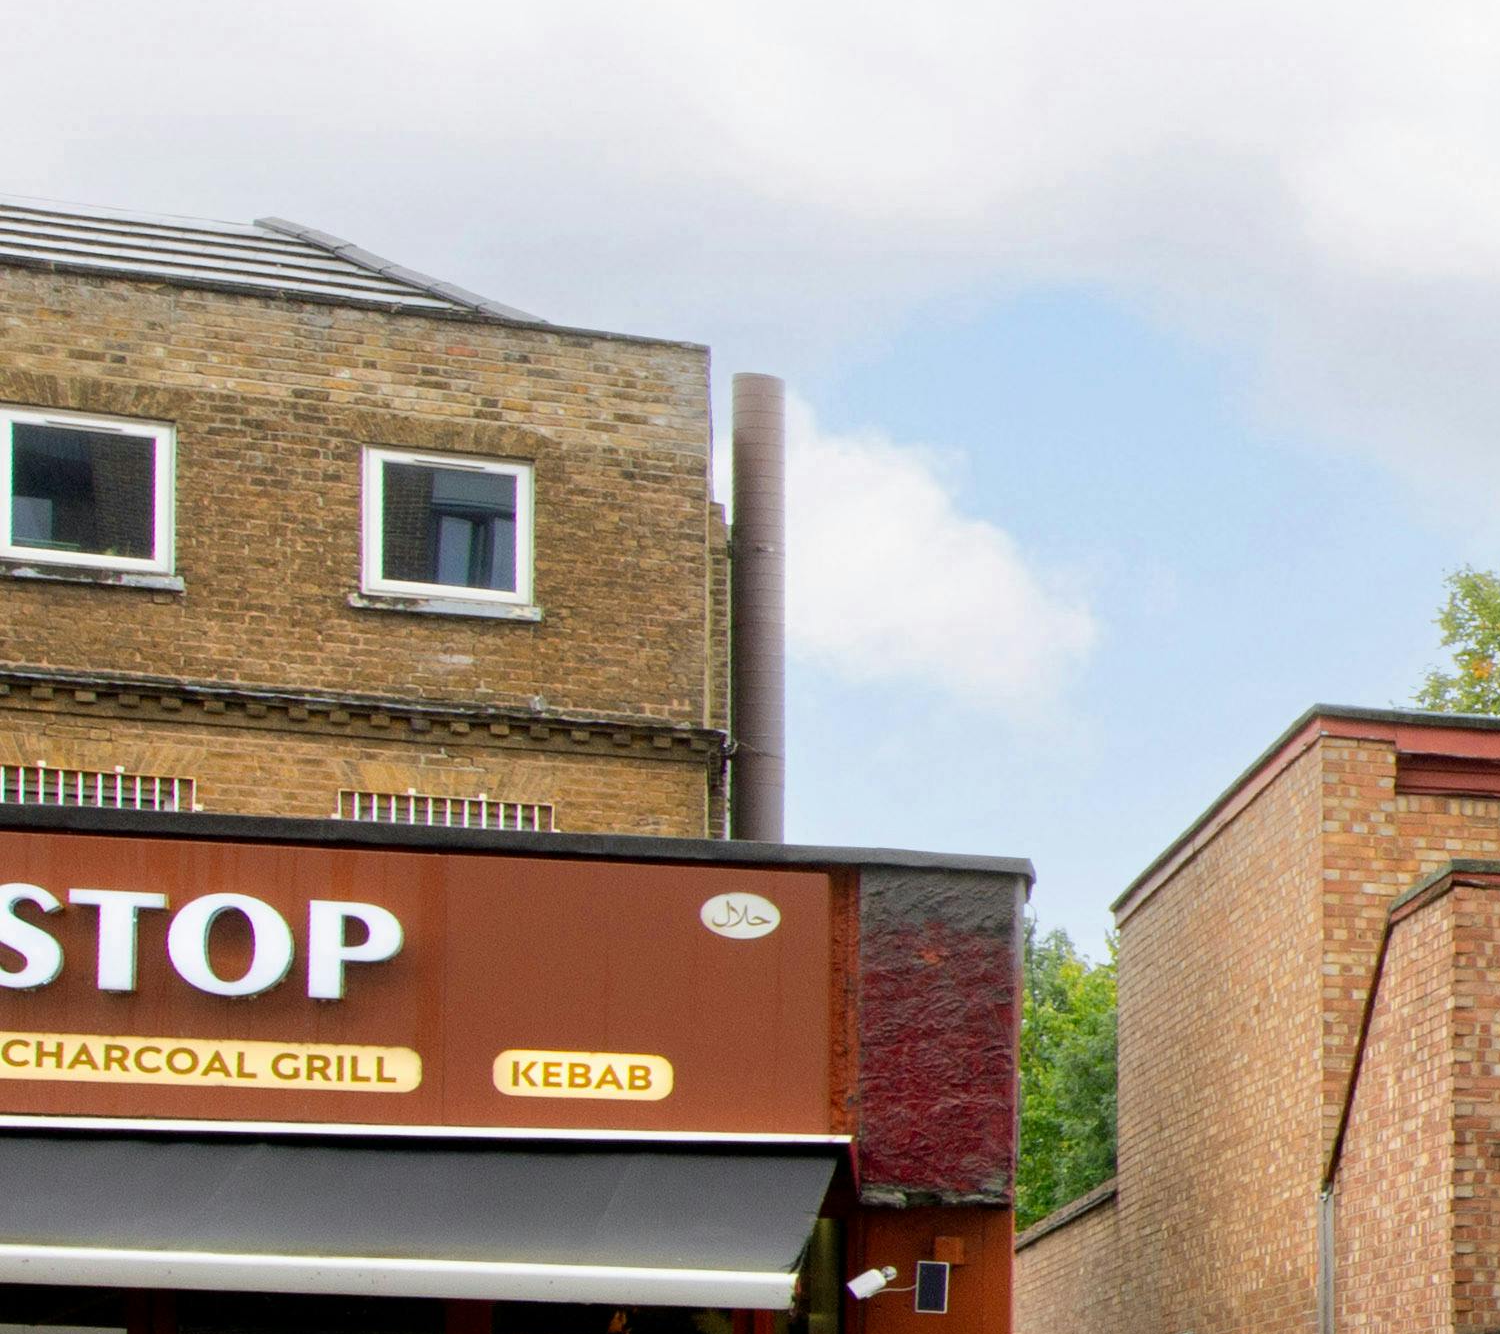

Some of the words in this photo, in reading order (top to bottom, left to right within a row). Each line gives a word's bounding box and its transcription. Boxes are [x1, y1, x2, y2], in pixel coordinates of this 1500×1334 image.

[711, 900, 773, 928] حلال
[0, 882, 405, 1000] STOP
[1, 1039, 257, 1079] CHARCOAL
[271, 1053, 398, 1083] GRILL
[511, 1061, 653, 1091] KEBAB
